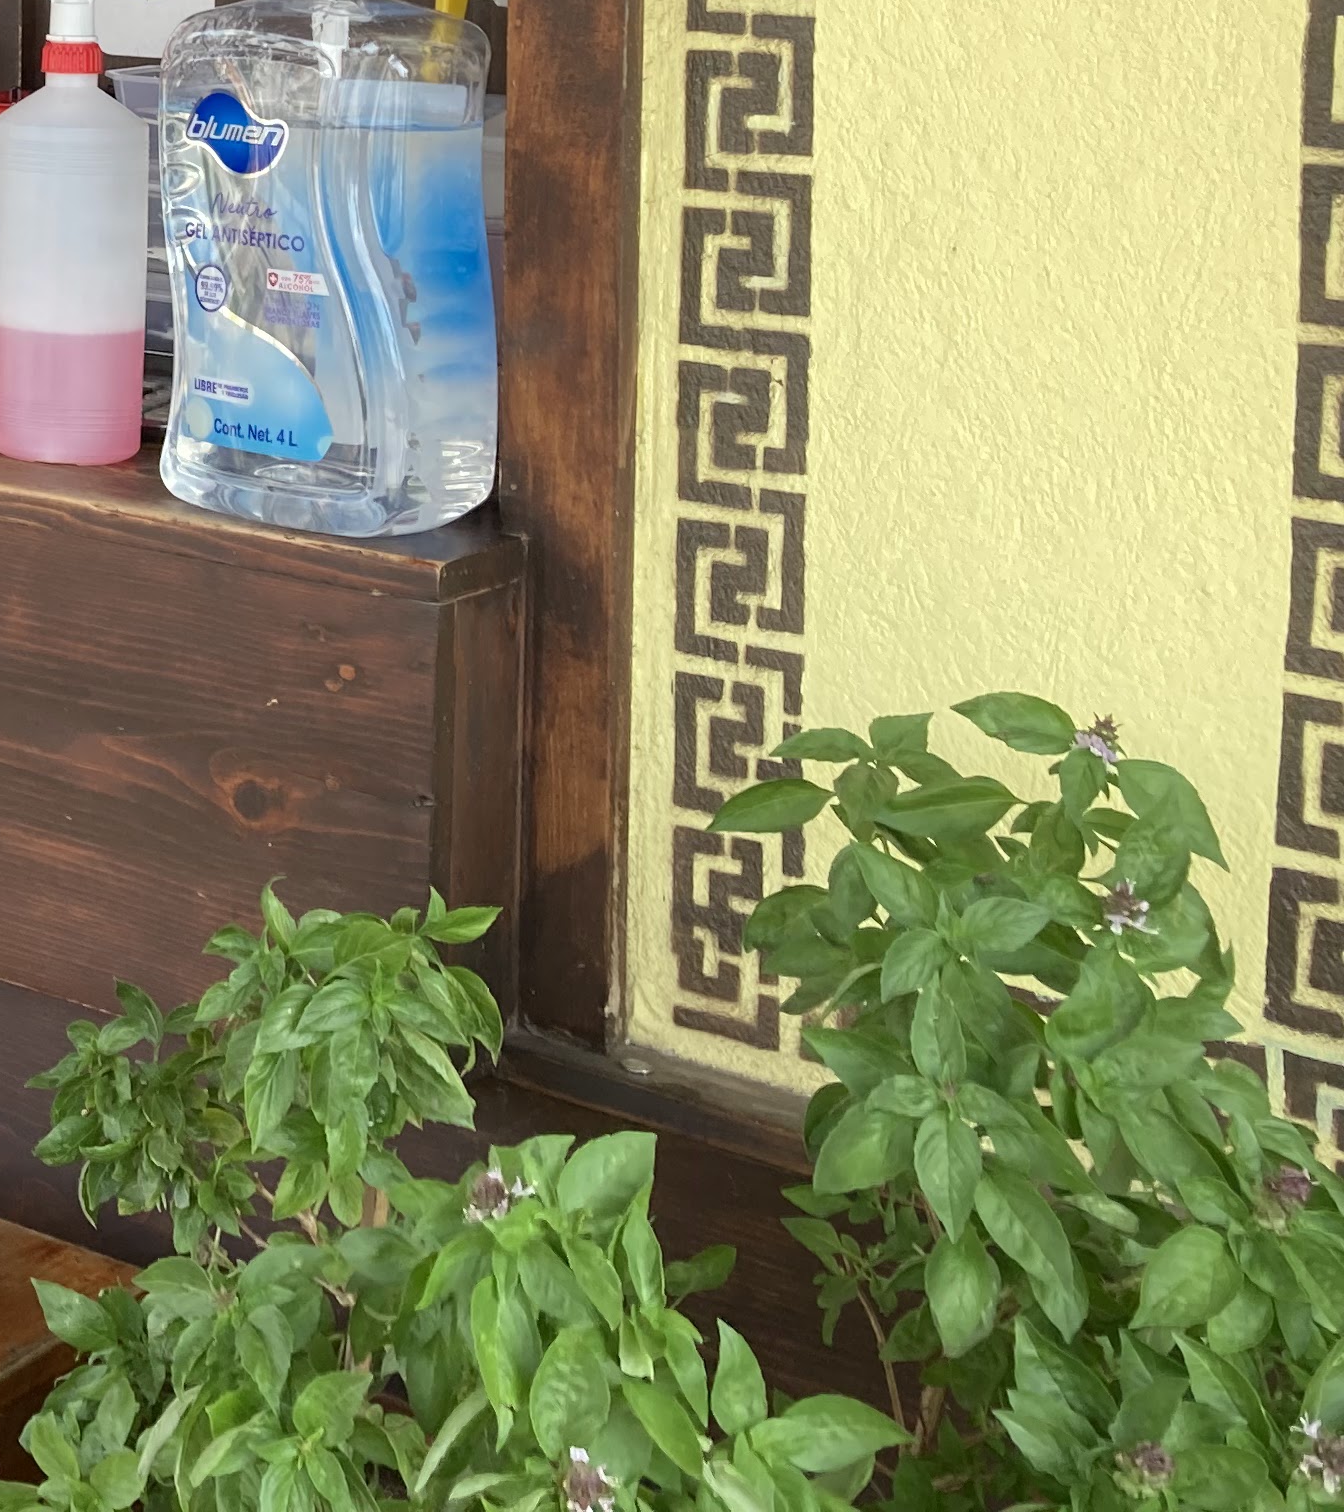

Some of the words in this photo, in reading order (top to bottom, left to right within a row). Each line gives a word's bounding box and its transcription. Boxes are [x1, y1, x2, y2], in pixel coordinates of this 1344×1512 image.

[187, 112, 285, 146] blumen
[212, 191, 278, 219] Neutro
[185, 222, 208, 240] GEL
[212, 225, 305, 252] ANTISÉPTICO
[194, 377, 217, 395] LIBRE
[214, 418, 245, 439] Cont.
[248, 424, 273, 444] Net.
[276, 429, 285, 445] 4
[288, 430, 298, 447] L
